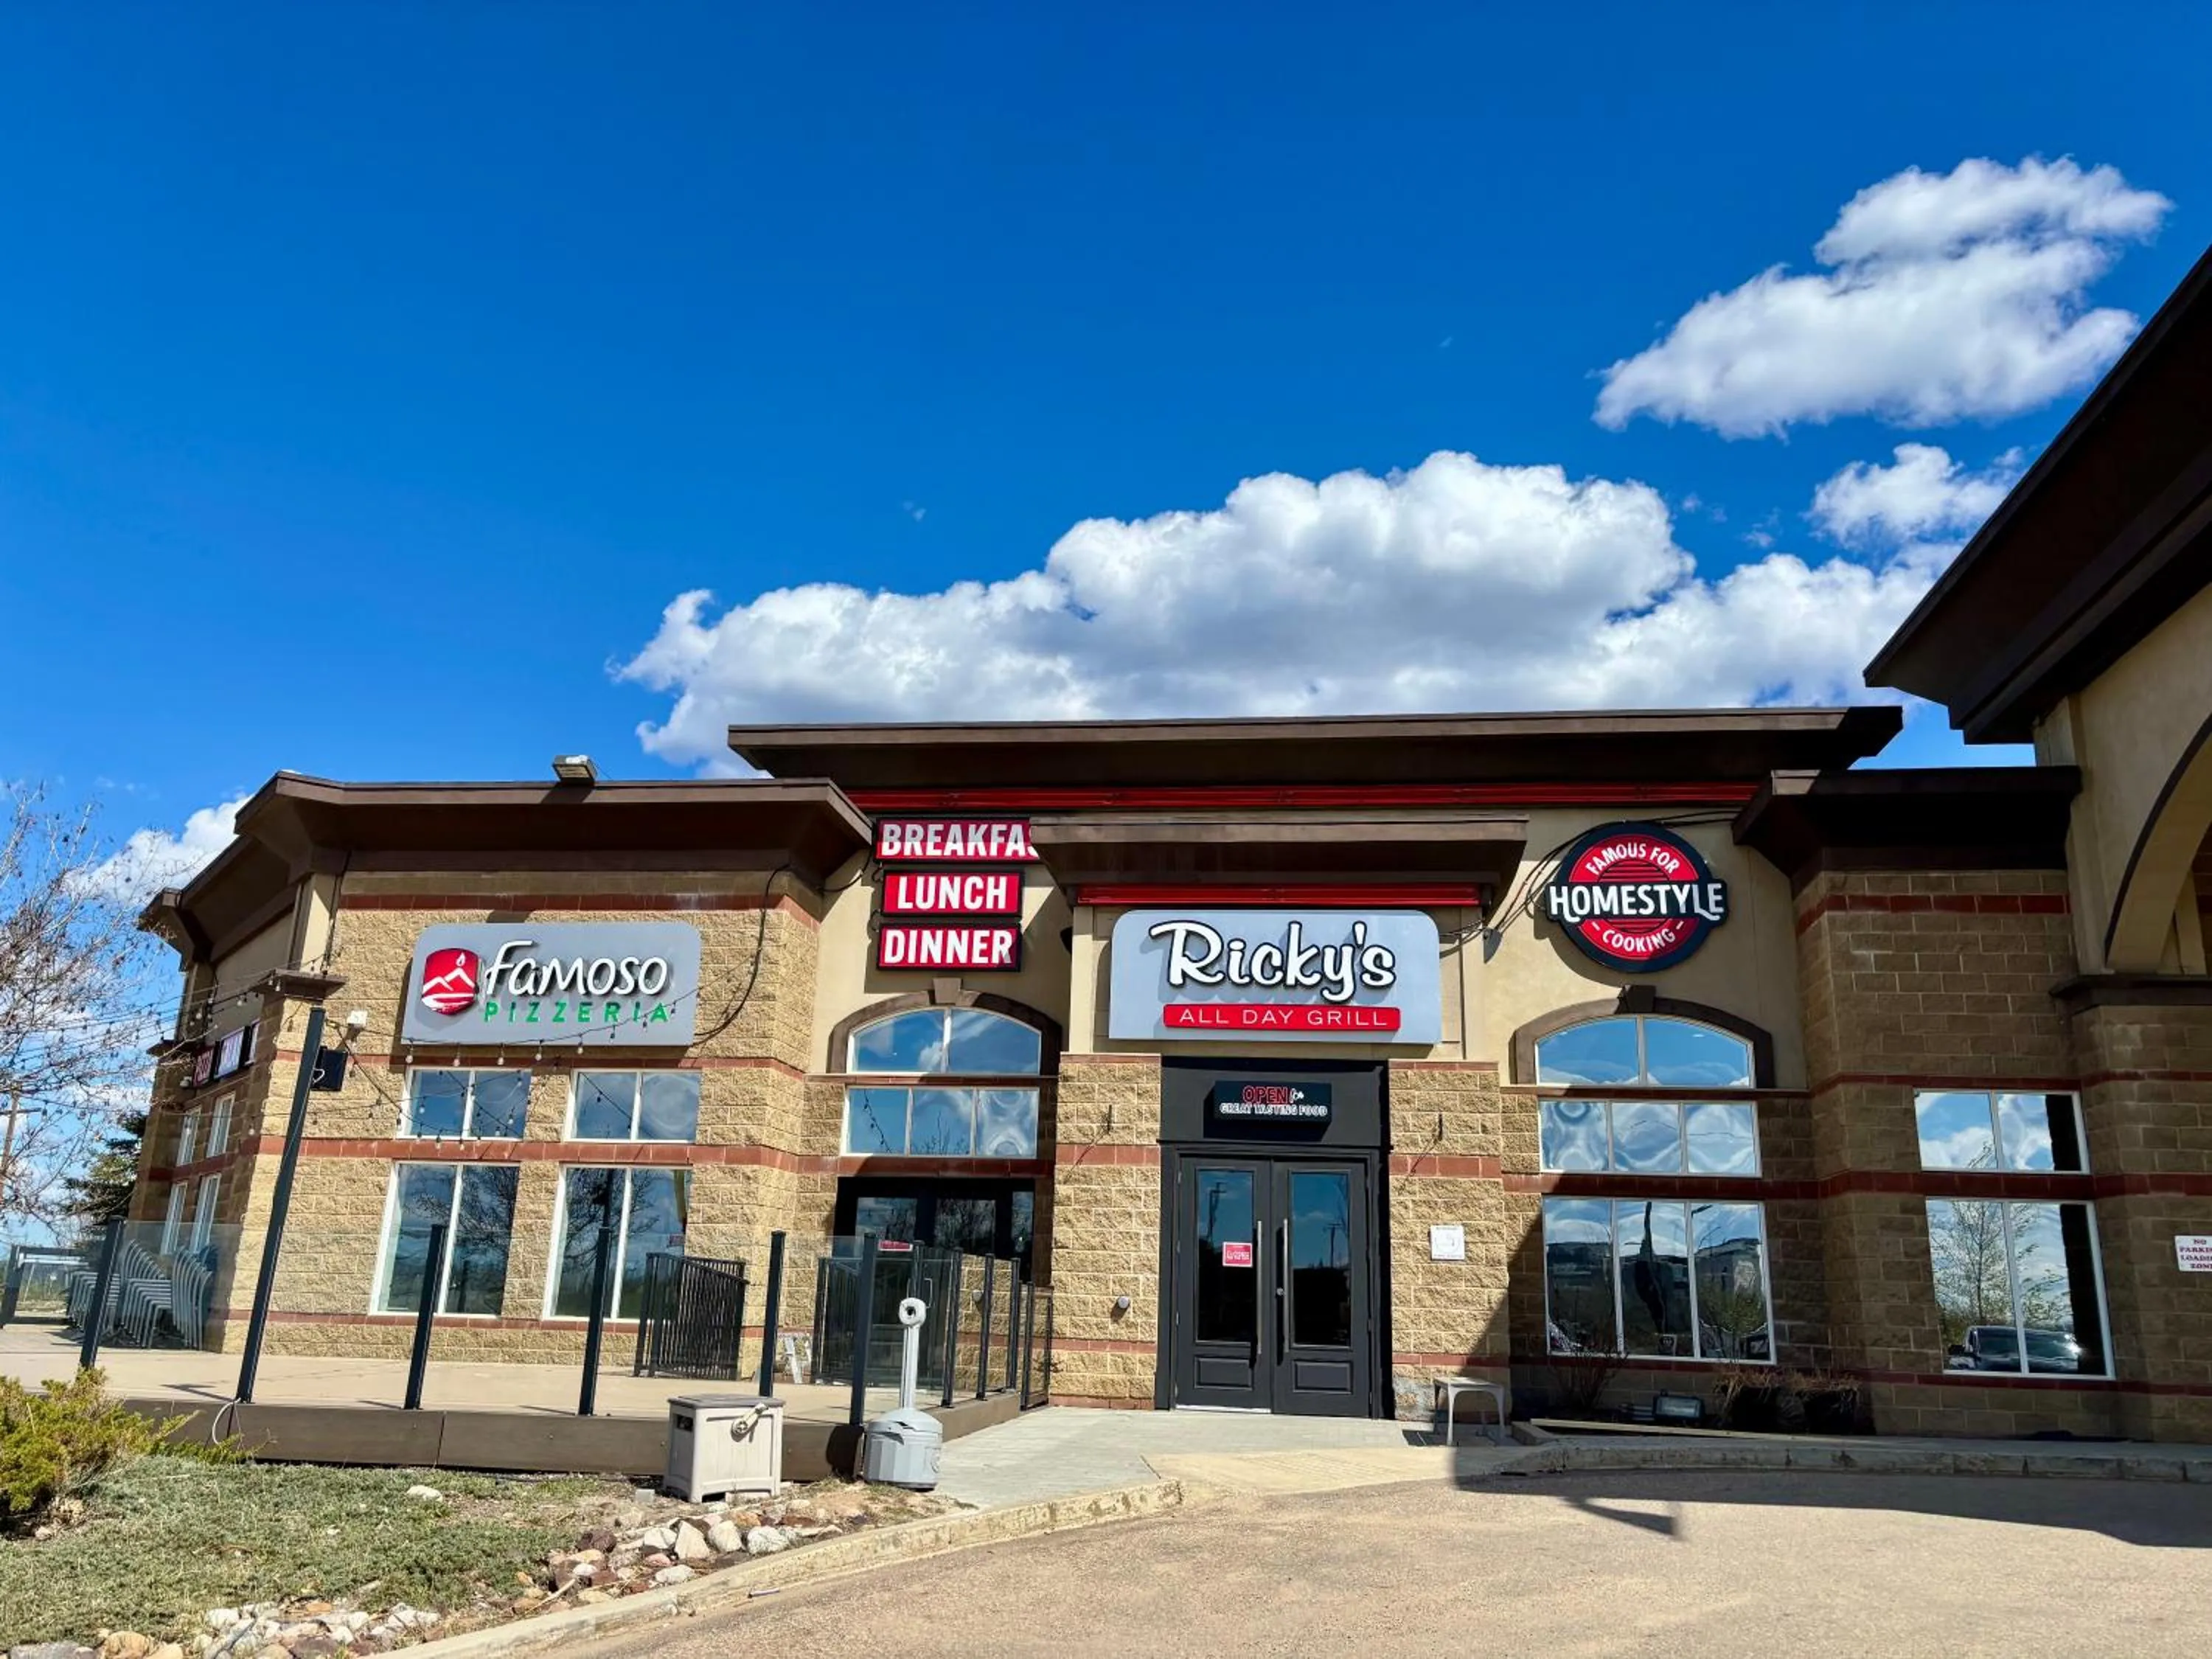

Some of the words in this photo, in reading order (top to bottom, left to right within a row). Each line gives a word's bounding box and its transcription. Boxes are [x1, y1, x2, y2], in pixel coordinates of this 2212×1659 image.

[1585, 842, 1646, 875] FAMOUS
[1649, 847, 1680, 874] FOR
[897, 875, 1007, 910] LUNCH
[1549, 883, 1725, 923] HOMESTYLE
[883, 929, 1012, 964] DINNER
[1601, 928, 1677, 953] COOKING
[1148, 919, 1397, 1004] Ricky's
[483, 1001, 669, 1023] PIZZERIA
[1179, 1009, 1229, 1025] ALL
[1242, 1009, 1294, 1025] DAY
[1307, 1009, 1388, 1026] GRILL
[1242, 1085, 1288, 1104] OPEN
[1298, 1105, 1328, 1117] FOOD
